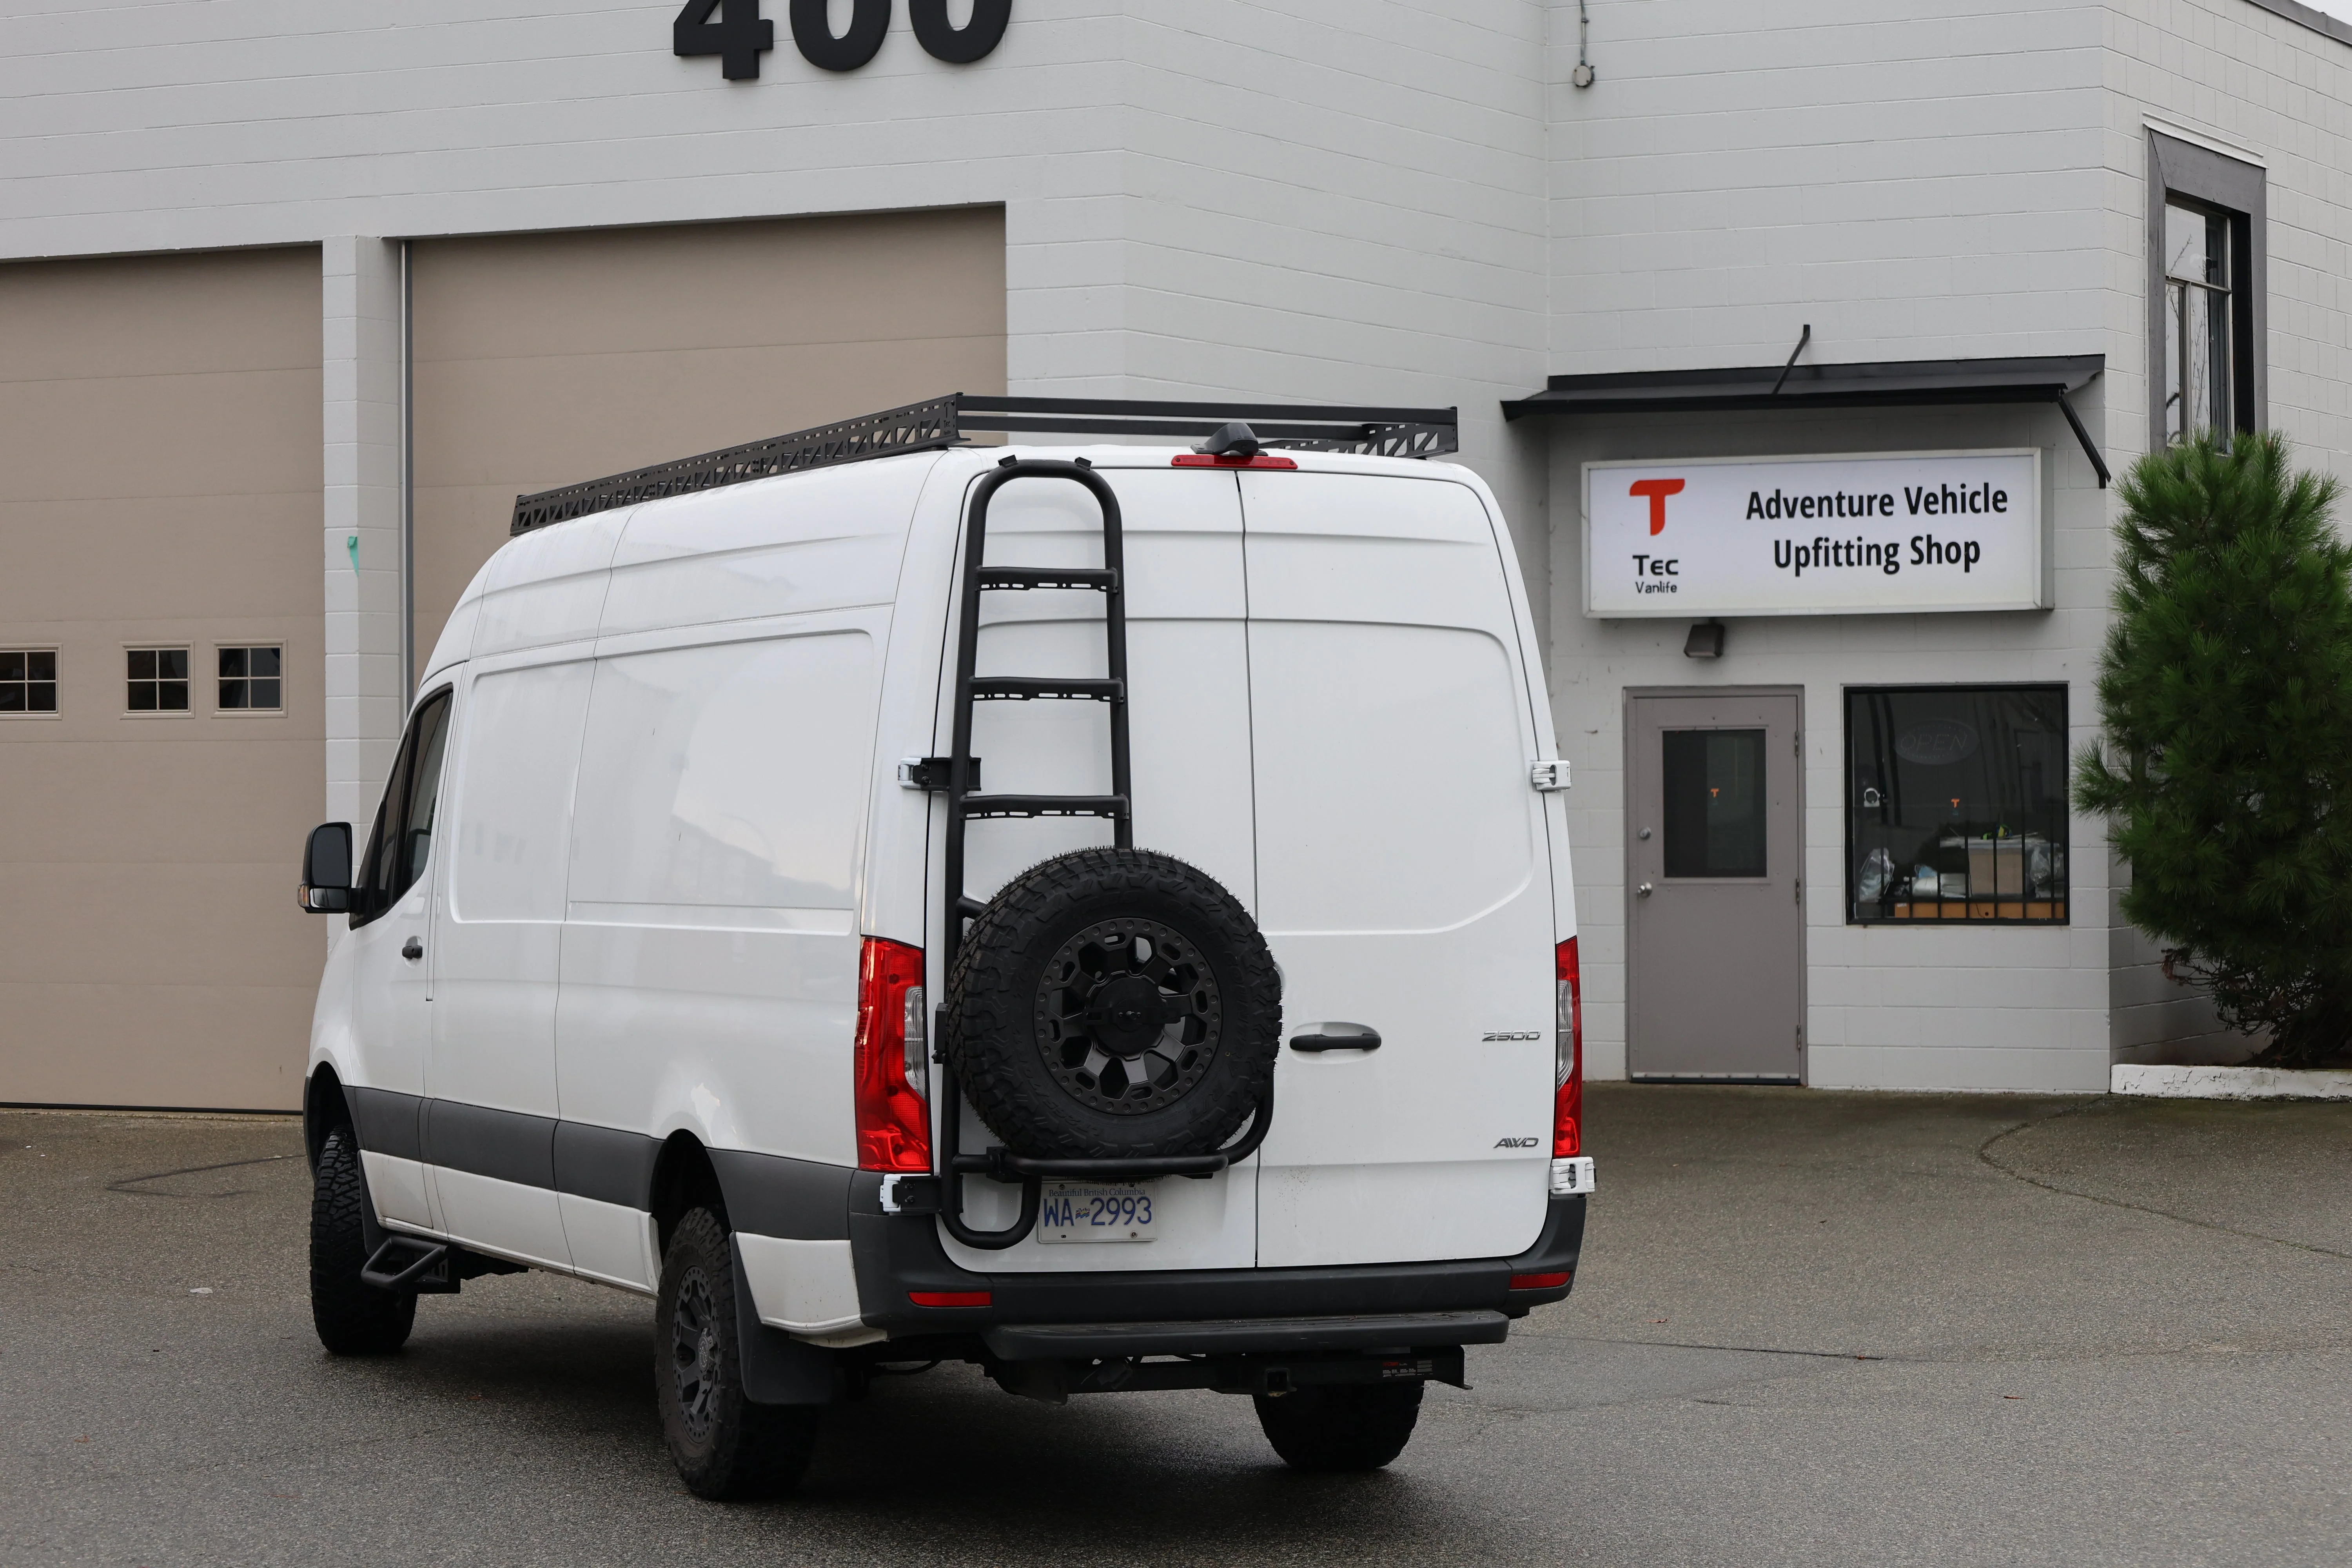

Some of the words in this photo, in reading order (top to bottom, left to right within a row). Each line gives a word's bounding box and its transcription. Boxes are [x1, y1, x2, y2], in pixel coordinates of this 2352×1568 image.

[1630, 479, 1686, 536] T
[1746, 489, 1895, 520] Adventure
[1904, 483, 2008, 515] Vehicle
[1632, 555, 1679, 576] Tec
[1774, 537, 1900, 577] Upfitting
[1911, 535, 1981, 573] Shop
[1635, 581, 1677, 594] Vanlife
[1900, 734, 1967, 751] OPEN
[1482, 1030, 1541, 1042] 2500
[1493, 1138, 1539, 1149] AWD
[1044, 1198, 1074, 1227] WA
[1090, 1197, 1152, 1226] 2993
